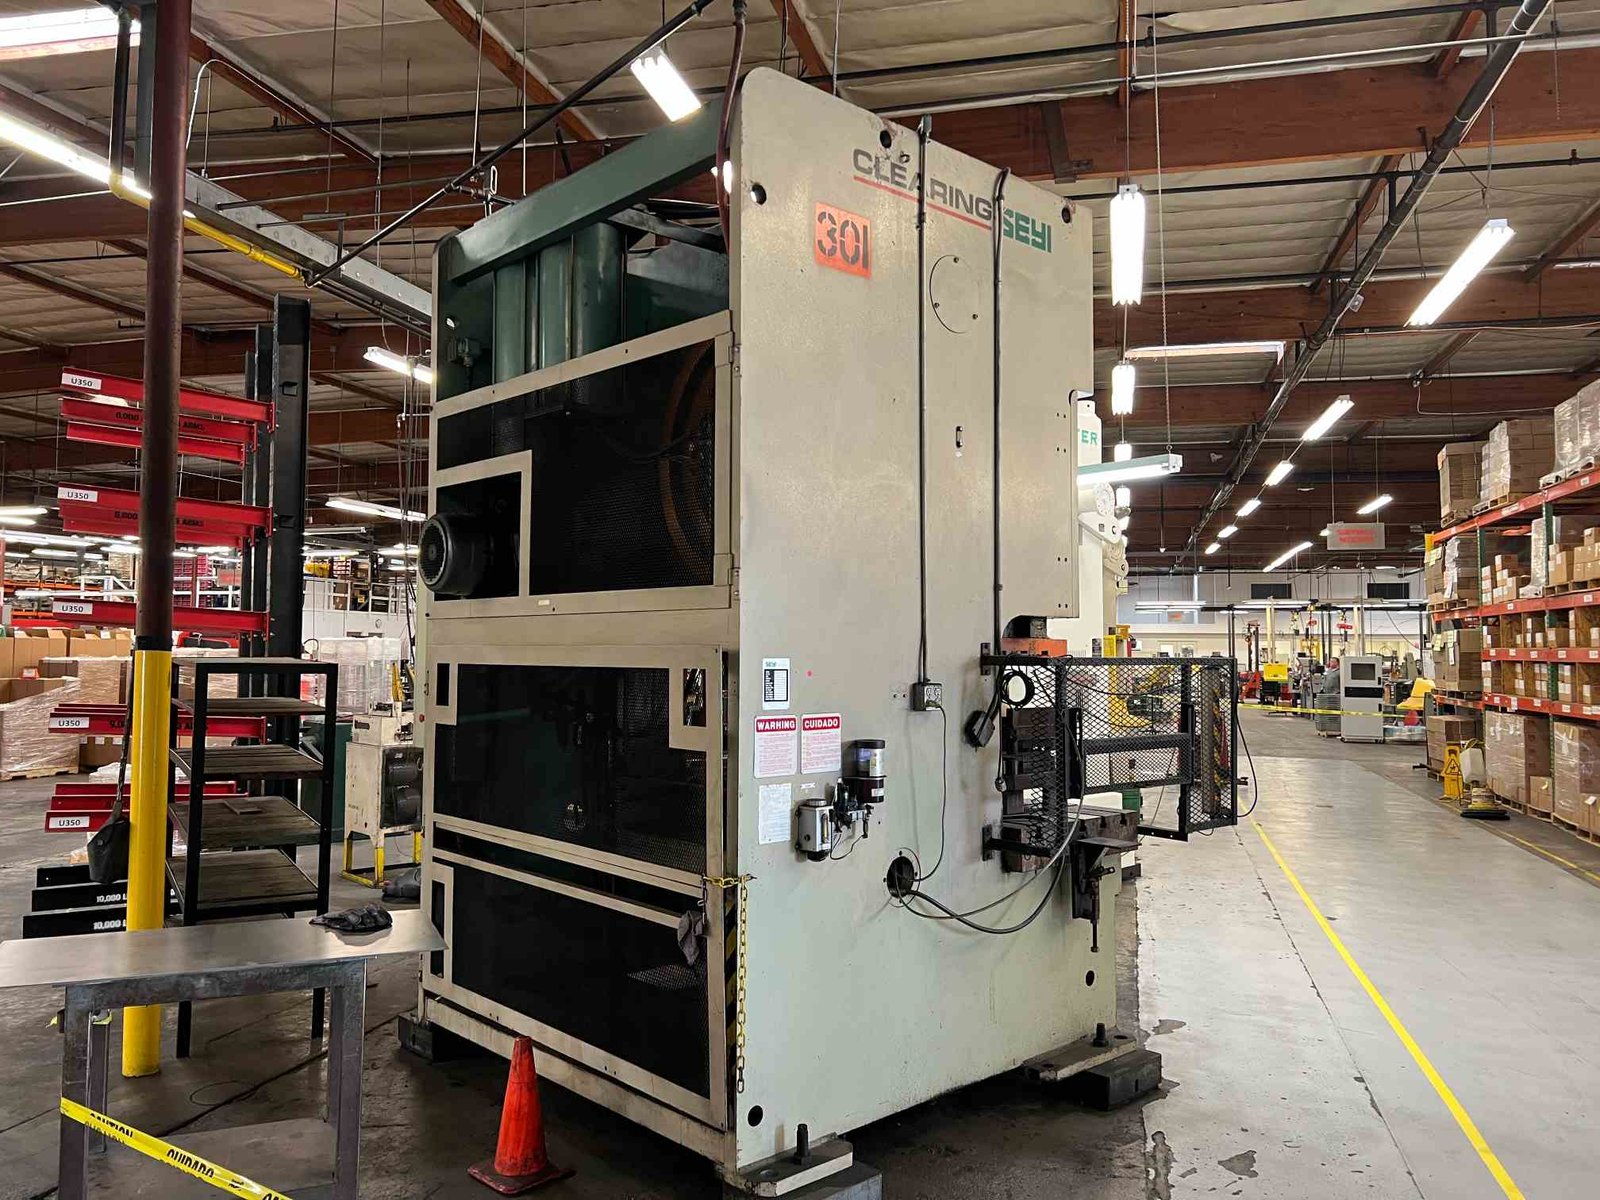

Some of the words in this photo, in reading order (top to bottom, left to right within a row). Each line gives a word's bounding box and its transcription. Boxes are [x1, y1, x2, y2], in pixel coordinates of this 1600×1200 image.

[853, 148, 993, 221] CLEARING
[1002, 206, 1052, 253] SEYI
[817, 211, 869, 269] 301
[70, 378, 93, 387] U350
[1078, 429, 1098, 445] ER
[67, 492, 89, 500] U350
[61, 605, 84, 613] U350
[58, 719, 81, 727] U350
[757, 720, 796, 731] WARNING
[804, 718, 839, 729] CUIDADO
[58, 819, 81, 827] U350
[93, 919, 121, 930] 10,000
